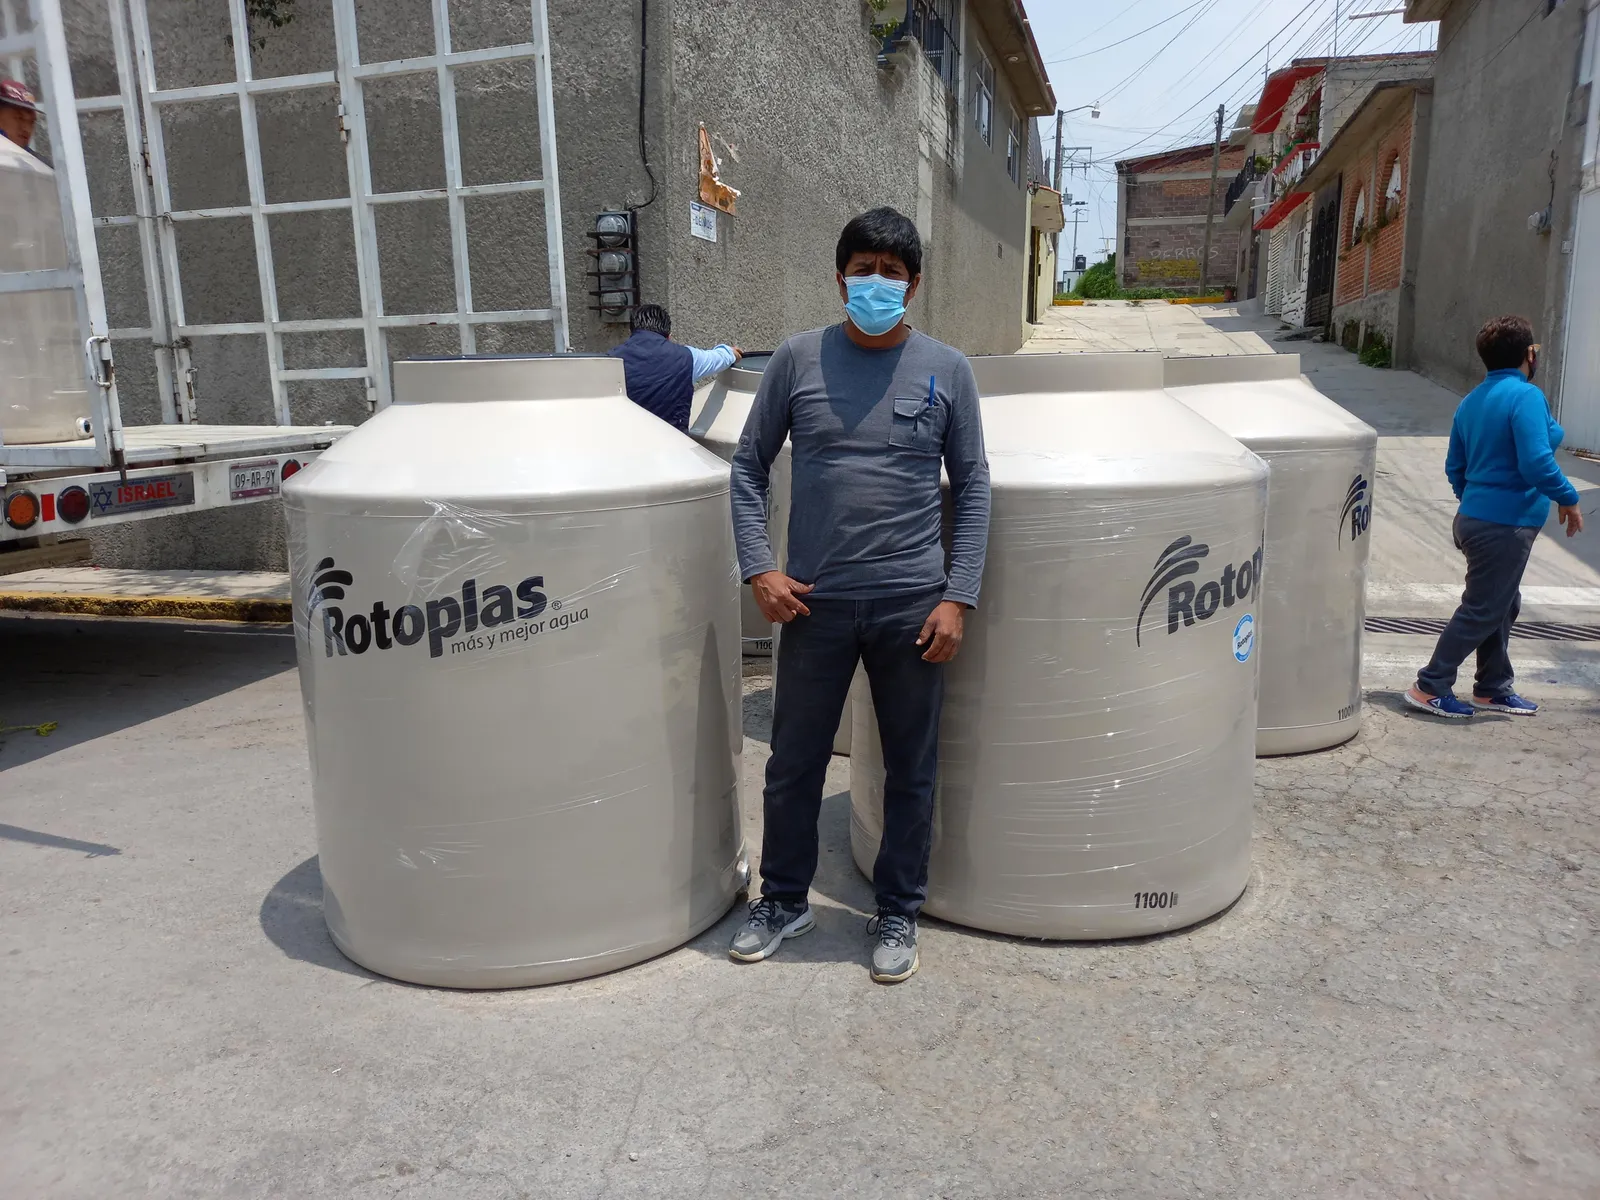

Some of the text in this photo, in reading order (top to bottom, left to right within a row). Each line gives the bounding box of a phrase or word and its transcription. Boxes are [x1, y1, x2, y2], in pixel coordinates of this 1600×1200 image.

[117, 481, 176, 504] ISRAEL
[235, 469, 276, 488] 09-AR-9Y
[322, 575, 548, 658] Rotoplas
[451, 608, 589, 654] más y mejor agua
